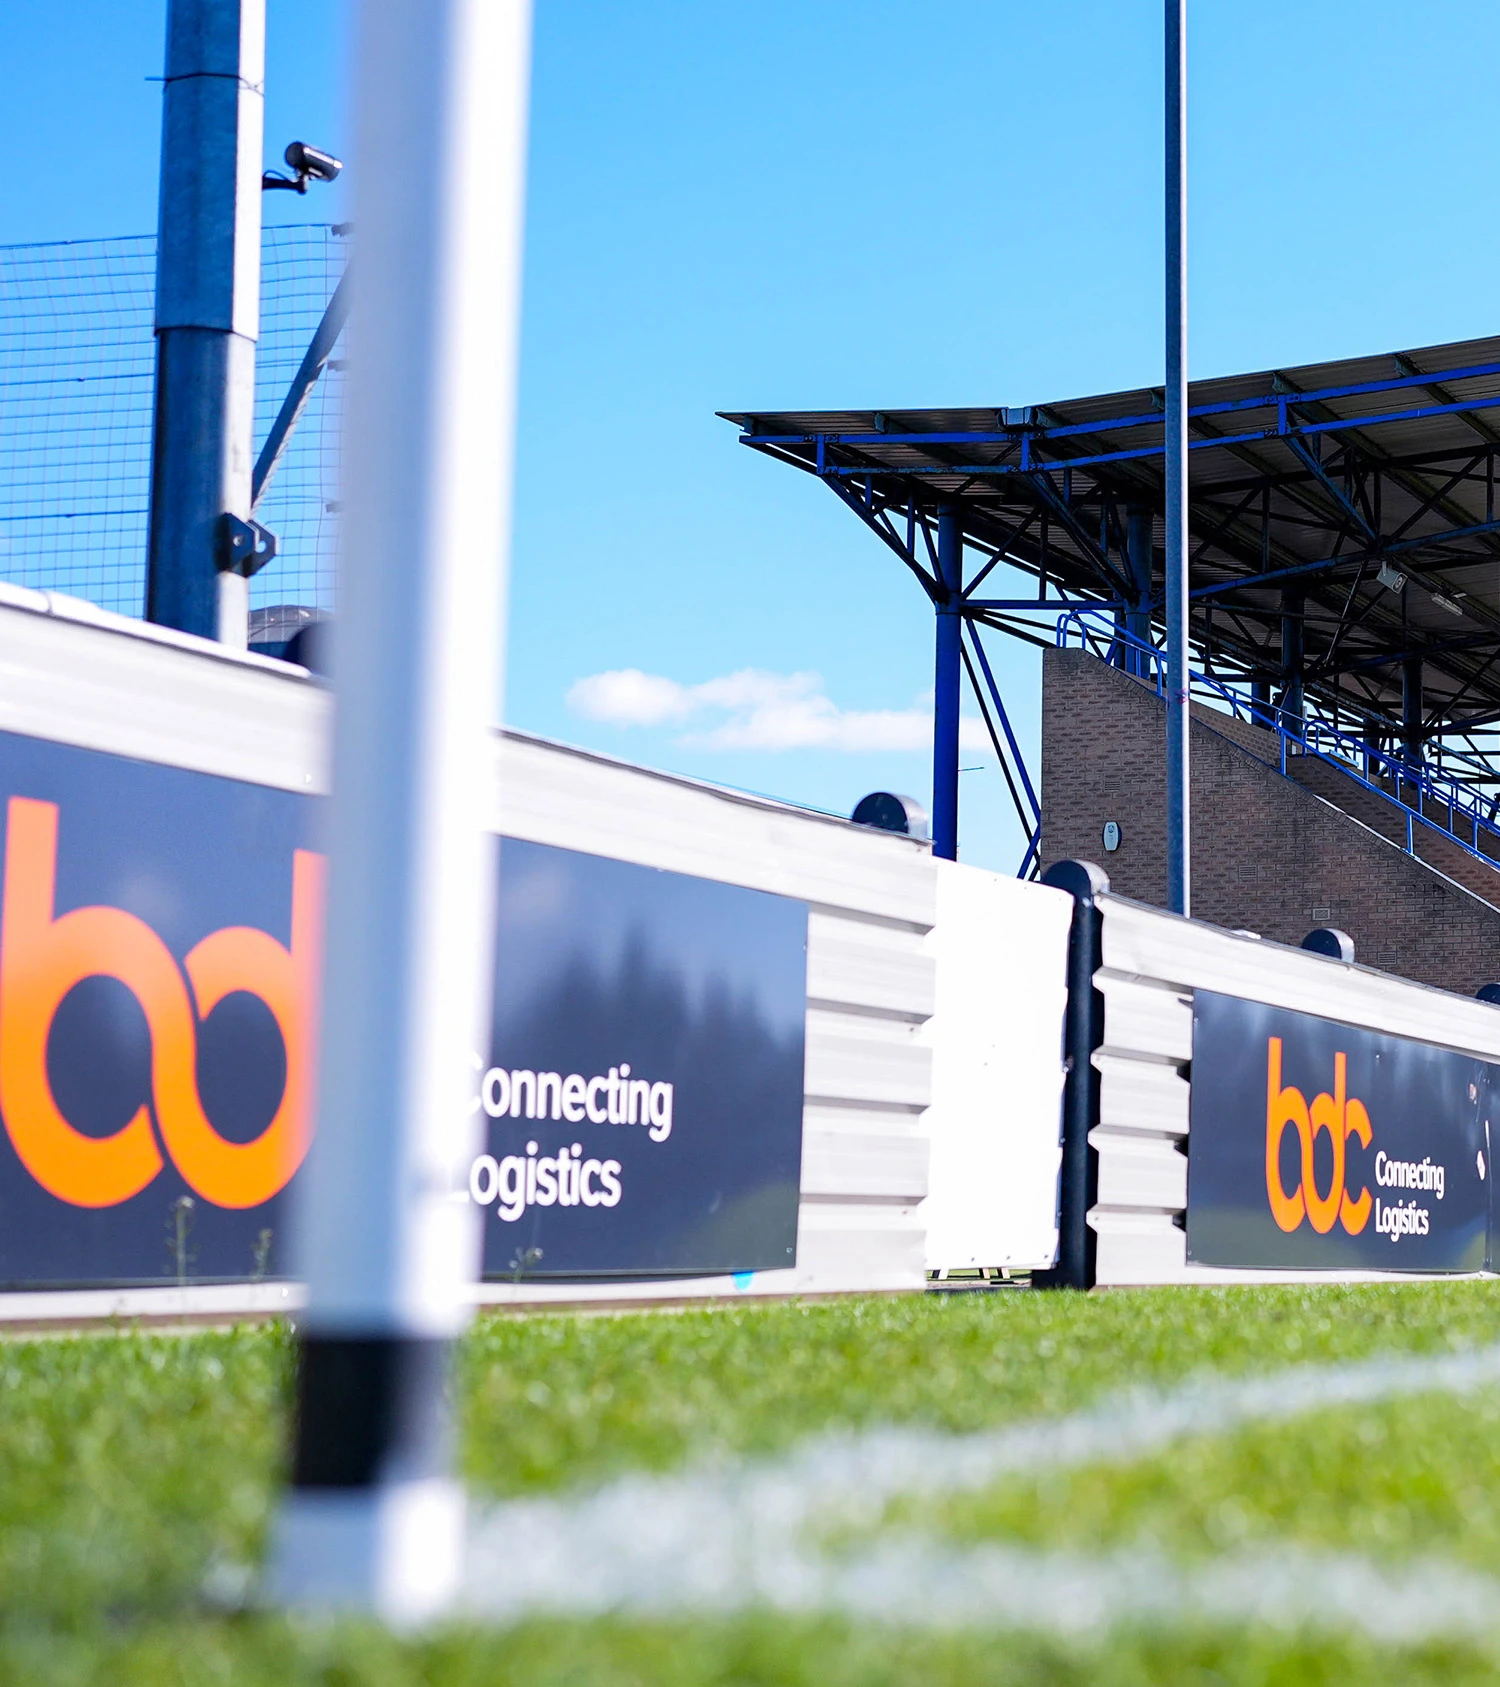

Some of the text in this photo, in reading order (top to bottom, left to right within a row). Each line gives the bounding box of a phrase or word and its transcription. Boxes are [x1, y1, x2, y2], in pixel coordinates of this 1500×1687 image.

[0, 796, 330, 1211] bd
[1265, 1036, 1374, 1236] bdc
[1374, 1150, 1445, 1200] Connecting
[452, 1140, 622, 1223] ogistics
[1374, 1197, 1430, 1243] Logistics
